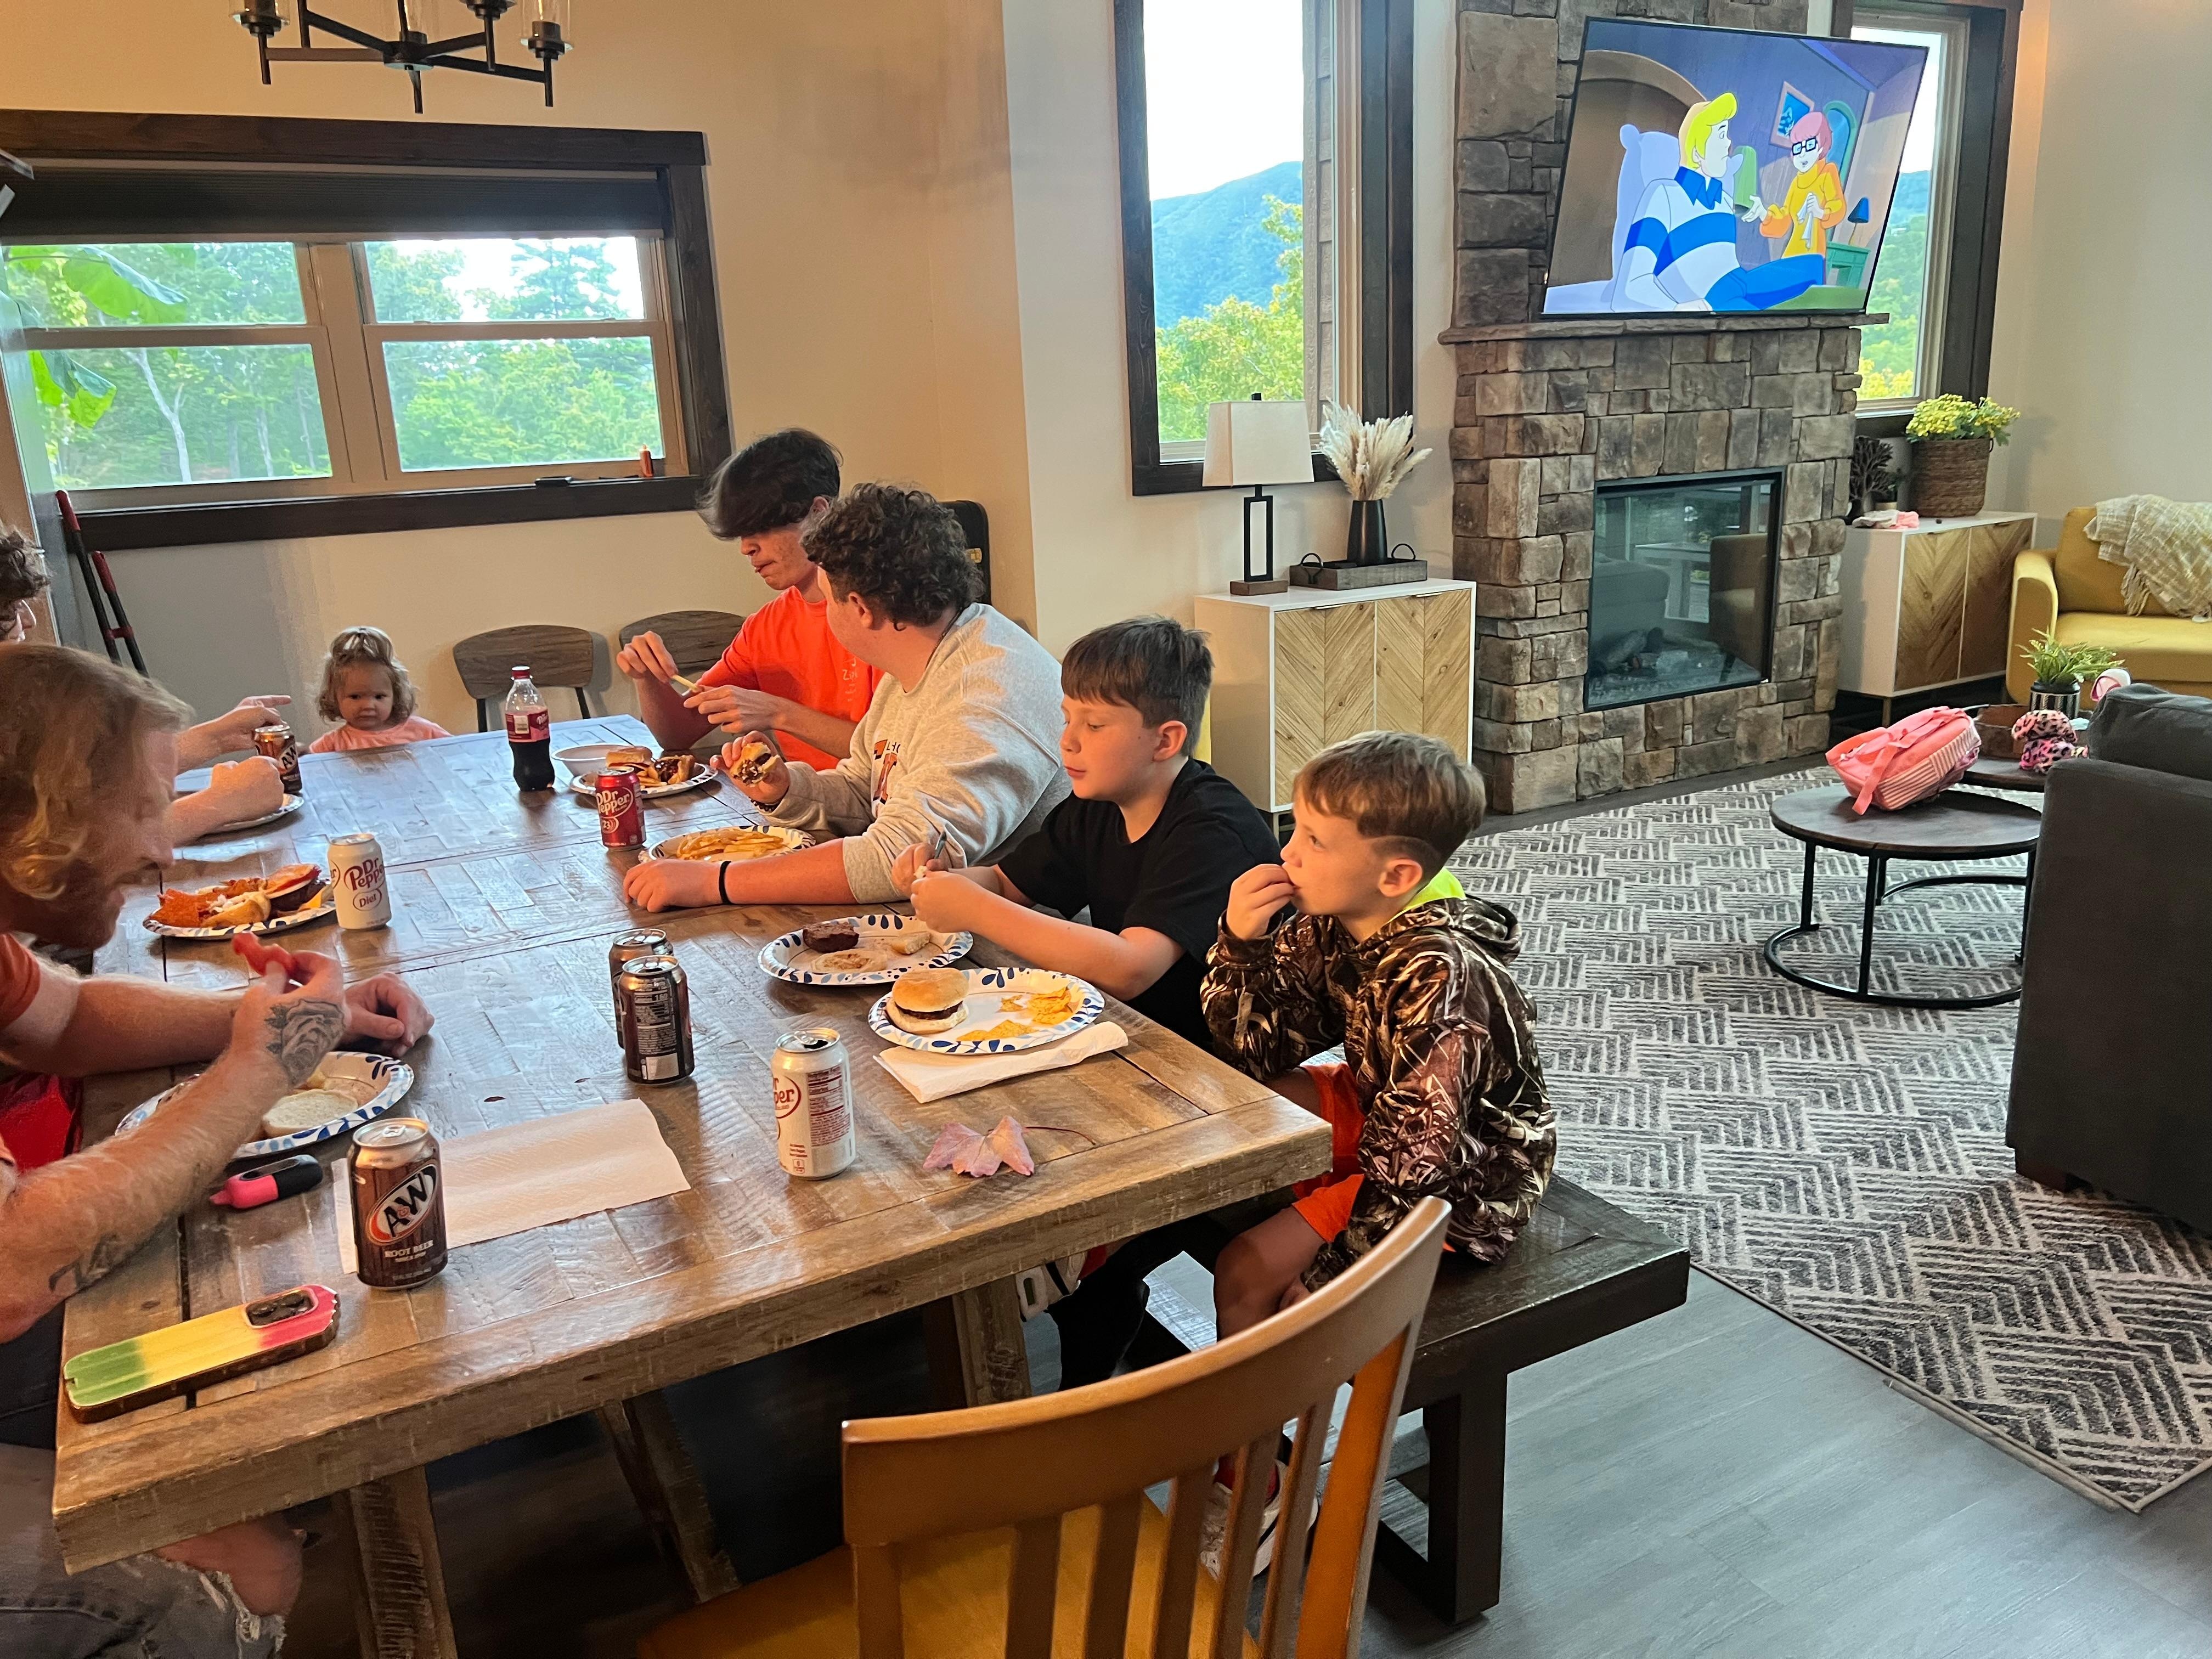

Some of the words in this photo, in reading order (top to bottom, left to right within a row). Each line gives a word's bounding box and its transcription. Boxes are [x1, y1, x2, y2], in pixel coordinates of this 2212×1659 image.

[596, 793, 630, 815] Pepper
[601, 790, 618, 803] Dr
[362, 857, 379, 876] Dr
[344, 863, 383, 891] Peppe
[359, 894, 377, 907] Diet
[774, 1089, 794, 1107] per
[384, 1173, 427, 1237] A&W
[385, 1248, 411, 1257] ROOT
[414, 1240, 433, 1253] BEER
